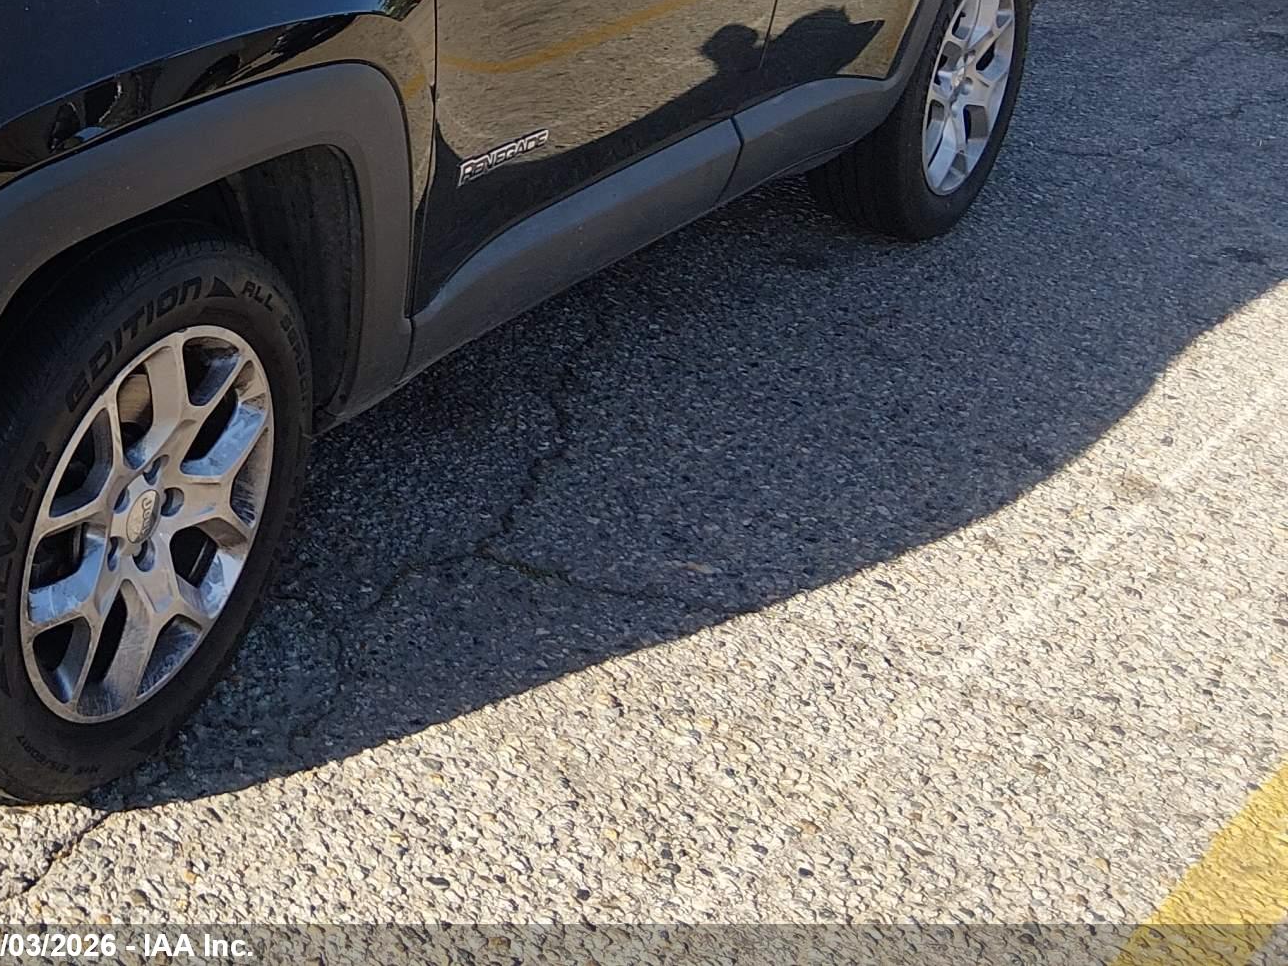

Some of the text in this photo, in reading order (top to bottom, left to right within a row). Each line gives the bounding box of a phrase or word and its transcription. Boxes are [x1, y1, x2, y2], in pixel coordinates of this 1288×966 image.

[458, 129, 549, 187] RENEGADE
[241, 280, 274, 311] ALL
[66, 276, 202, 411] EDITION
